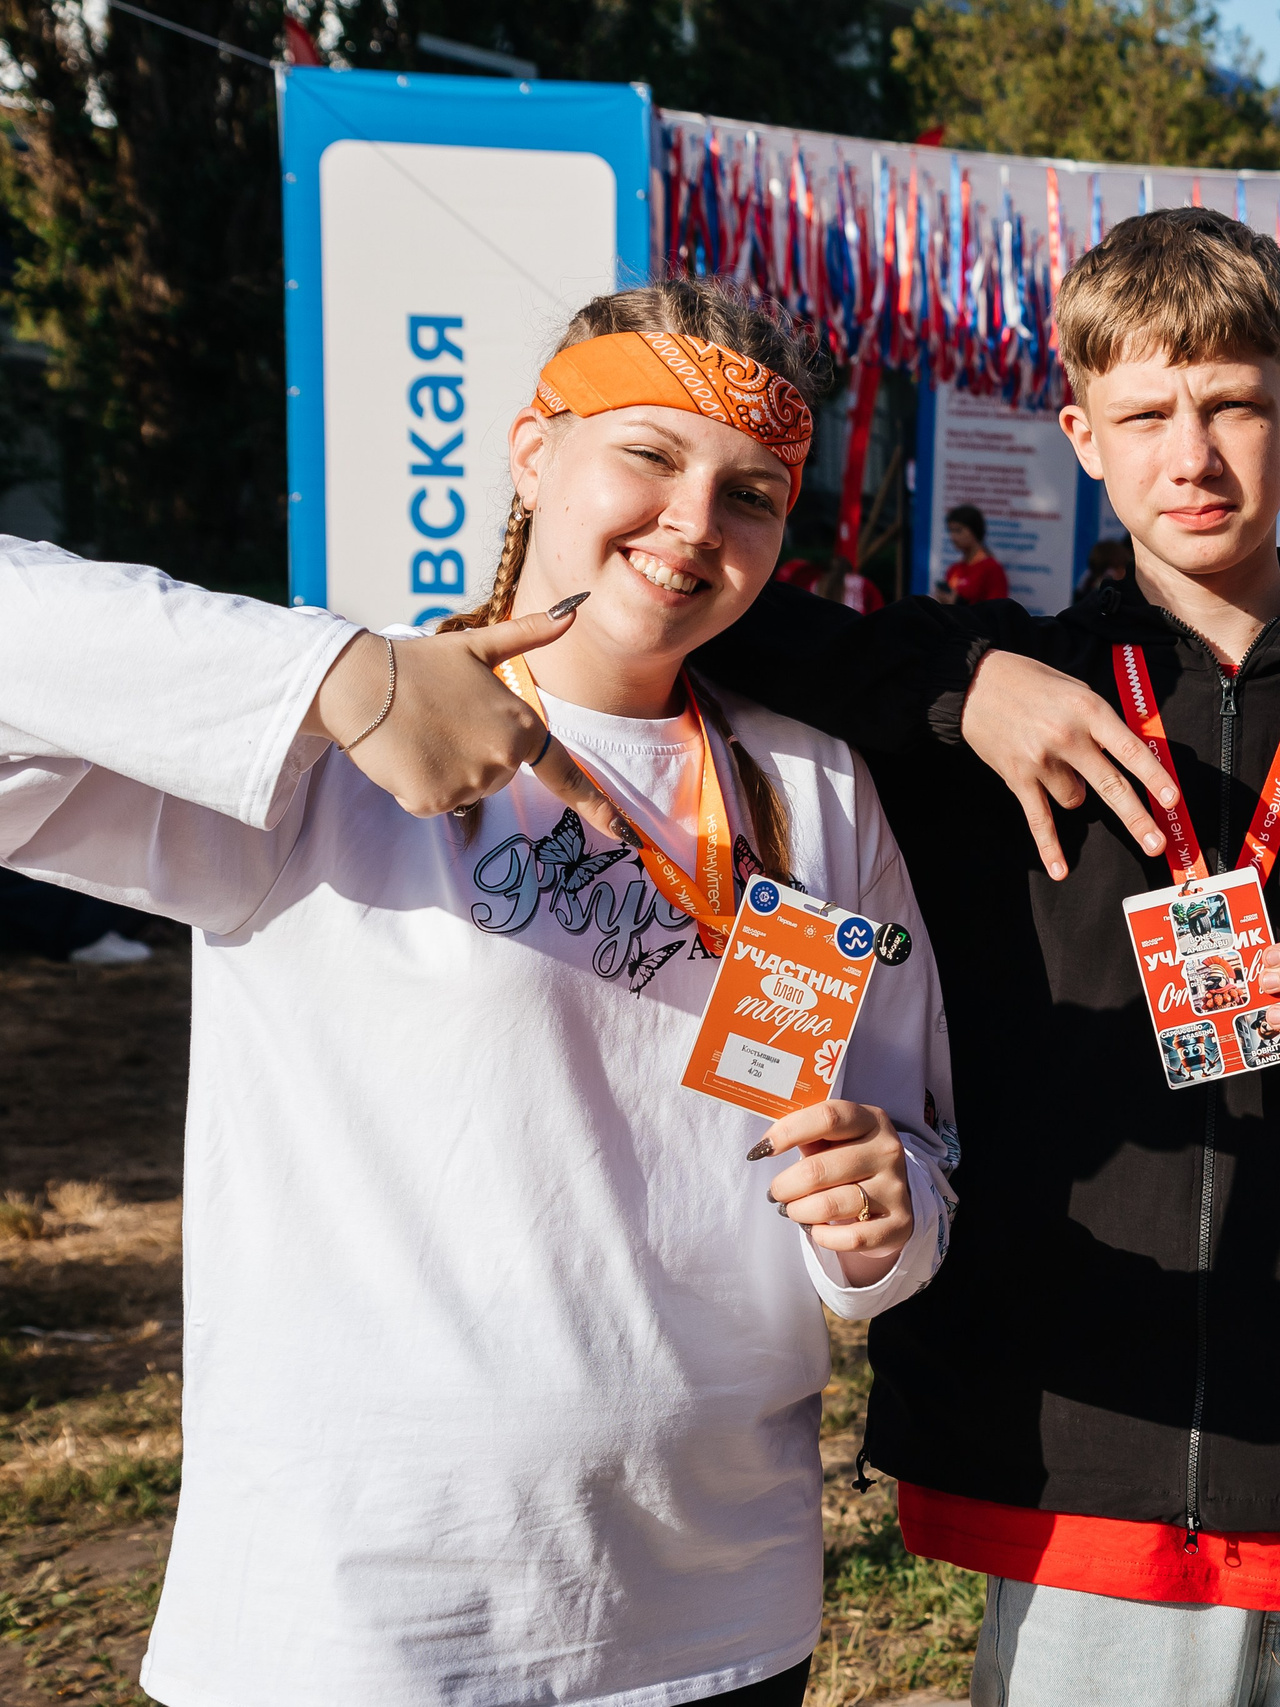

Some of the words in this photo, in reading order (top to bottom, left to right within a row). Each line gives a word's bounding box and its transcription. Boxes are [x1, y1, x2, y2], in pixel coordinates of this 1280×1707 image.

[407, 312, 466, 627] вская
[706, 814, 719, 834] не
[1172, 824, 1185, 842] не
[702, 834, 724, 915] волнуйтесь
[733, 940, 859, 1005] УЧАСТНИК
[772, 977, 805, 1005] благо
[733, 995, 833, 1045] творю
[747, 1067, 763, 1078] 4/20
